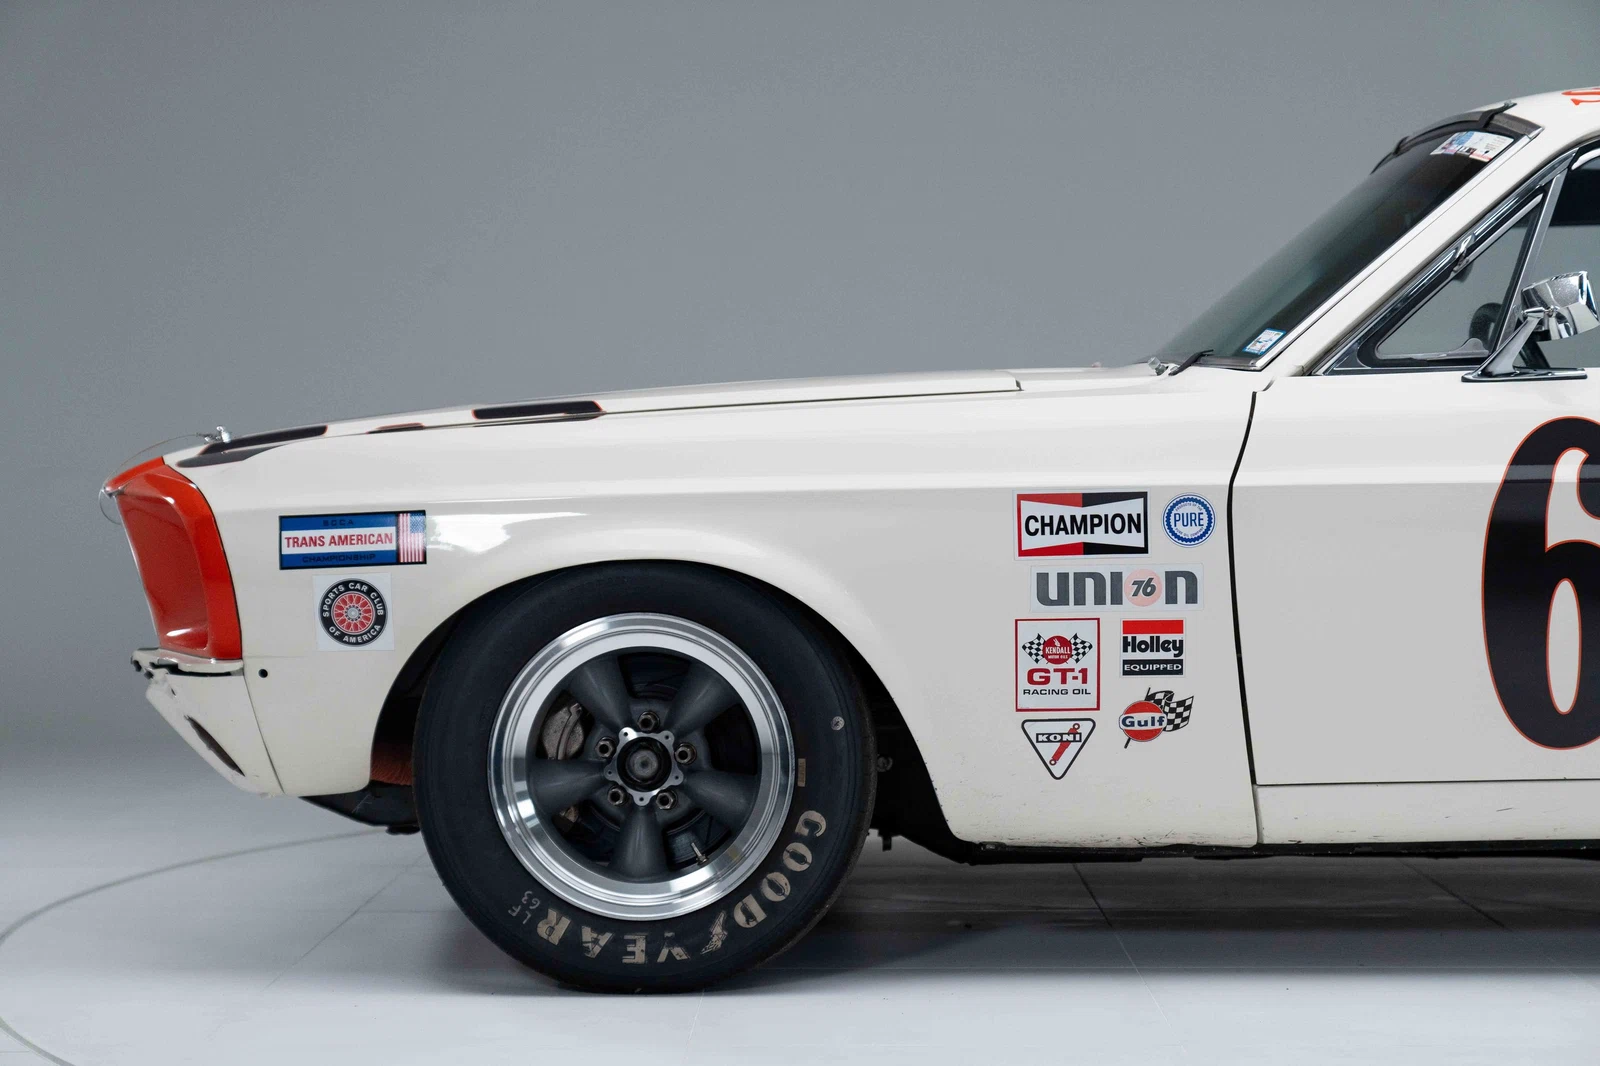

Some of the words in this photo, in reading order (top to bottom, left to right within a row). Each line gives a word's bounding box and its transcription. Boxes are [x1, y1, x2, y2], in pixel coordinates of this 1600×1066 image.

[1024, 512, 1142, 536] CHAMPION
[1173, 512, 1204, 527] PURE
[285, 535, 325, 548] TRANS
[329, 533, 393, 546] AMERICAN
[302, 553, 376, 563] CHAMPIONSHIP
[1131, 577, 1157, 597] 76
[322, 584, 345, 617] SPORTS
[348, 582, 368, 592] CAR
[370, 592, 384, 615] CLUB
[329, 626, 341, 637] OF
[343, 624, 381, 643] AMERICA
[1045, 646, 1070, 654] KENDALL
[1122, 636, 1183, 658] Holley
[1027, 668, 1088, 686] GT-1
[1121, 715, 1165, 728] Gulf
[1037, 734, 1080, 742] KONI
